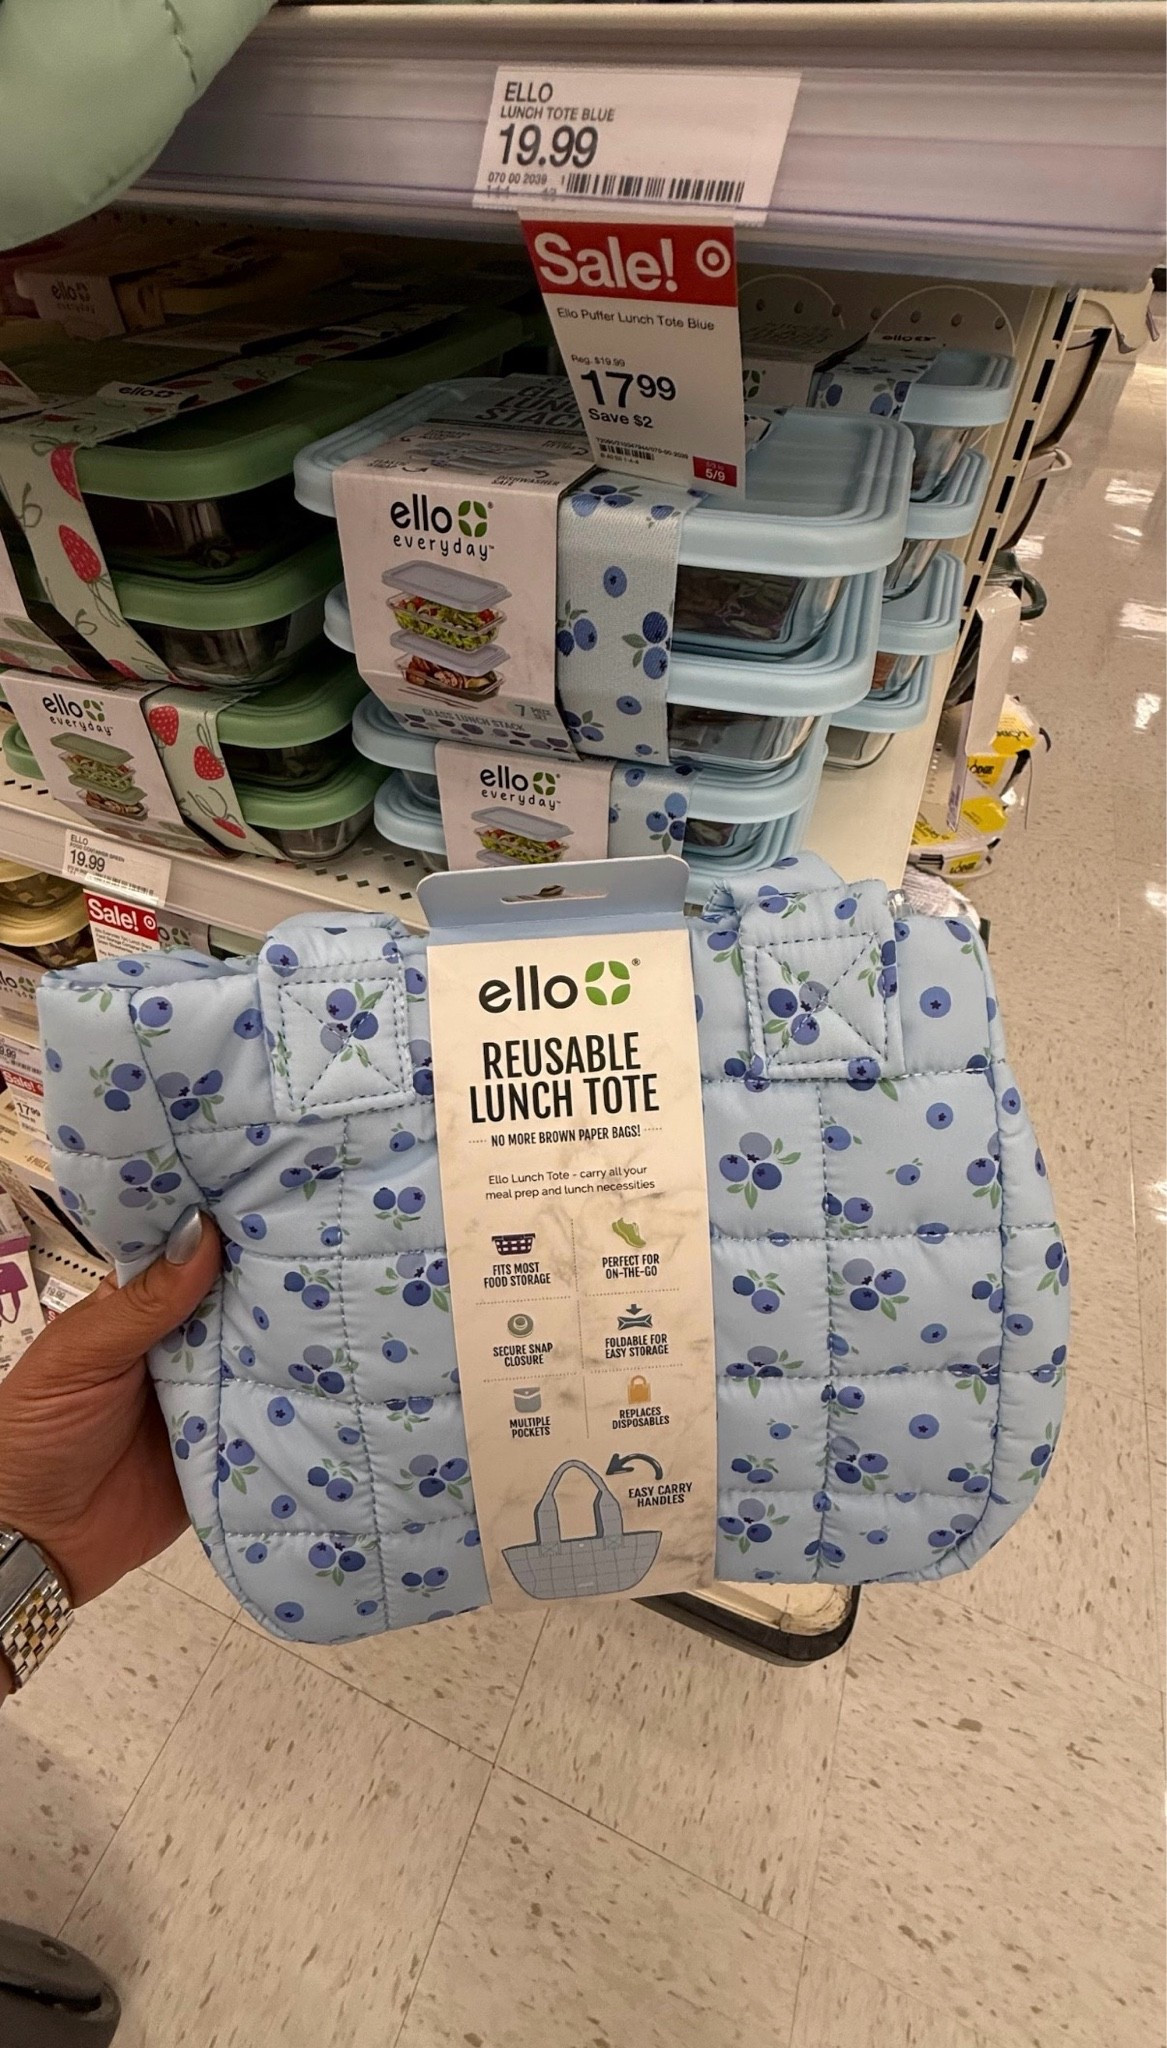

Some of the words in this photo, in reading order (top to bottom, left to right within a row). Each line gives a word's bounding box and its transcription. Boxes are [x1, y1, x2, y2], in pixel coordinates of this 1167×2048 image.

[504, 81, 553, 103] ELLO
[500, 106, 543, 120] LUNCH
[547, 107, 578, 121] TOTE
[581, 108, 615, 122] BLUE
[499, 123, 598, 168] 19.99
[488, 172, 505, 184] 070
[508, 173, 520, 184] 00
[534, 232, 678, 293] Sale!
[557, 307, 578, 319] Ello
[581, 309, 615, 322] Puffer
[618, 311, 654, 325] Lunch
[658, 315, 684, 328] Tote
[688, 318, 715, 331] Blue
[571, 354, 592, 366] Reg.
[595, 355, 626, 367] $19.99
[119, 385, 154, 397] ello
[588, 408, 629, 425] Save
[633, 414, 654, 429] $2
[705, 468, 725, 482] 5/9
[390, 493, 453, 533] ello
[393, 534, 489, 561] everyday
[42, 693, 83, 718] ello
[515, 704, 526, 716] 7
[50, 715, 111, 736] everyday
[421, 708, 454, 720] GLASS
[455, 713, 490, 726] LUNCH
[491, 719, 526, 732] STACK
[480, 765, 528, 791] ello
[481, 789, 555, 811] everyday
[70, 834, 88, 845] ELLO
[70, 849, 105, 872] 19.99
[88, 898, 139, 932] Sale!
[478, 965, 578, 1013] ello
[482, 1032, 641, 1080] REUSABLE
[2, 1070, 36, 1092] Sale!
[469, 1079, 573, 1123] LUNCH
[583, 1073, 660, 1115] TOTE
[491, 1134, 505, 1147] NO
[508, 1132, 536, 1146] MORE
[539, 1129, 575, 1143] BROWN
[578, 1127, 609, 1141] PAPER
[612, 1124, 641, 1138] BAGS!
[488, 1174, 509, 1185] Ello
[511, 1172, 544, 1183] Lunch
[548, 1171, 569, 1181] Tote
[580, 1168, 606, 1179] carry
[609, 1166, 622, 1176] all
[624, 1165, 648, 1177] your
[485, 1189, 512, 1200] meal
[514, 1188, 539, 1200] prep
[542, 1185, 562, 1196] and
[564, 1182, 594, 1194] lunch
[597, 1180, 655, 1192] necessities
[493, 1263, 512, 1276] FITS
[514, 1262, 540, 1274] MOST
[602, 1255, 640, 1268] PERFECT
[642, 1253, 660, 1265] FOR
[484, 1275, 508, 1288] FOOD
[510, 1272, 551, 1287] STORAGE
[606, 1266, 658, 1279] ON-THE-GO
[493, 1344, 527, 1357] SECURE
[529, 1342, 553, 1354] SNAP
[605, 1335, 649, 1348] FOLDABLE
[650, 1333, 667, 1345] FOR
[605, 1347, 628, 1359] EASY
[629, 1343, 669, 1357] STORAGE
[504, 1354, 544, 1367] CLOSURE
[619, 1406, 661, 1419] REPLACES
[509, 1416, 551, 1428] MULTIPLE
[612, 1415, 670, 1430] DISPOSABLES
[512, 1426, 550, 1438] POCKETS
[628, 1486, 654, 1499] EASY
[657, 1482, 692, 1496] CARRY
[637, 1493, 685, 1507] HANDLES
